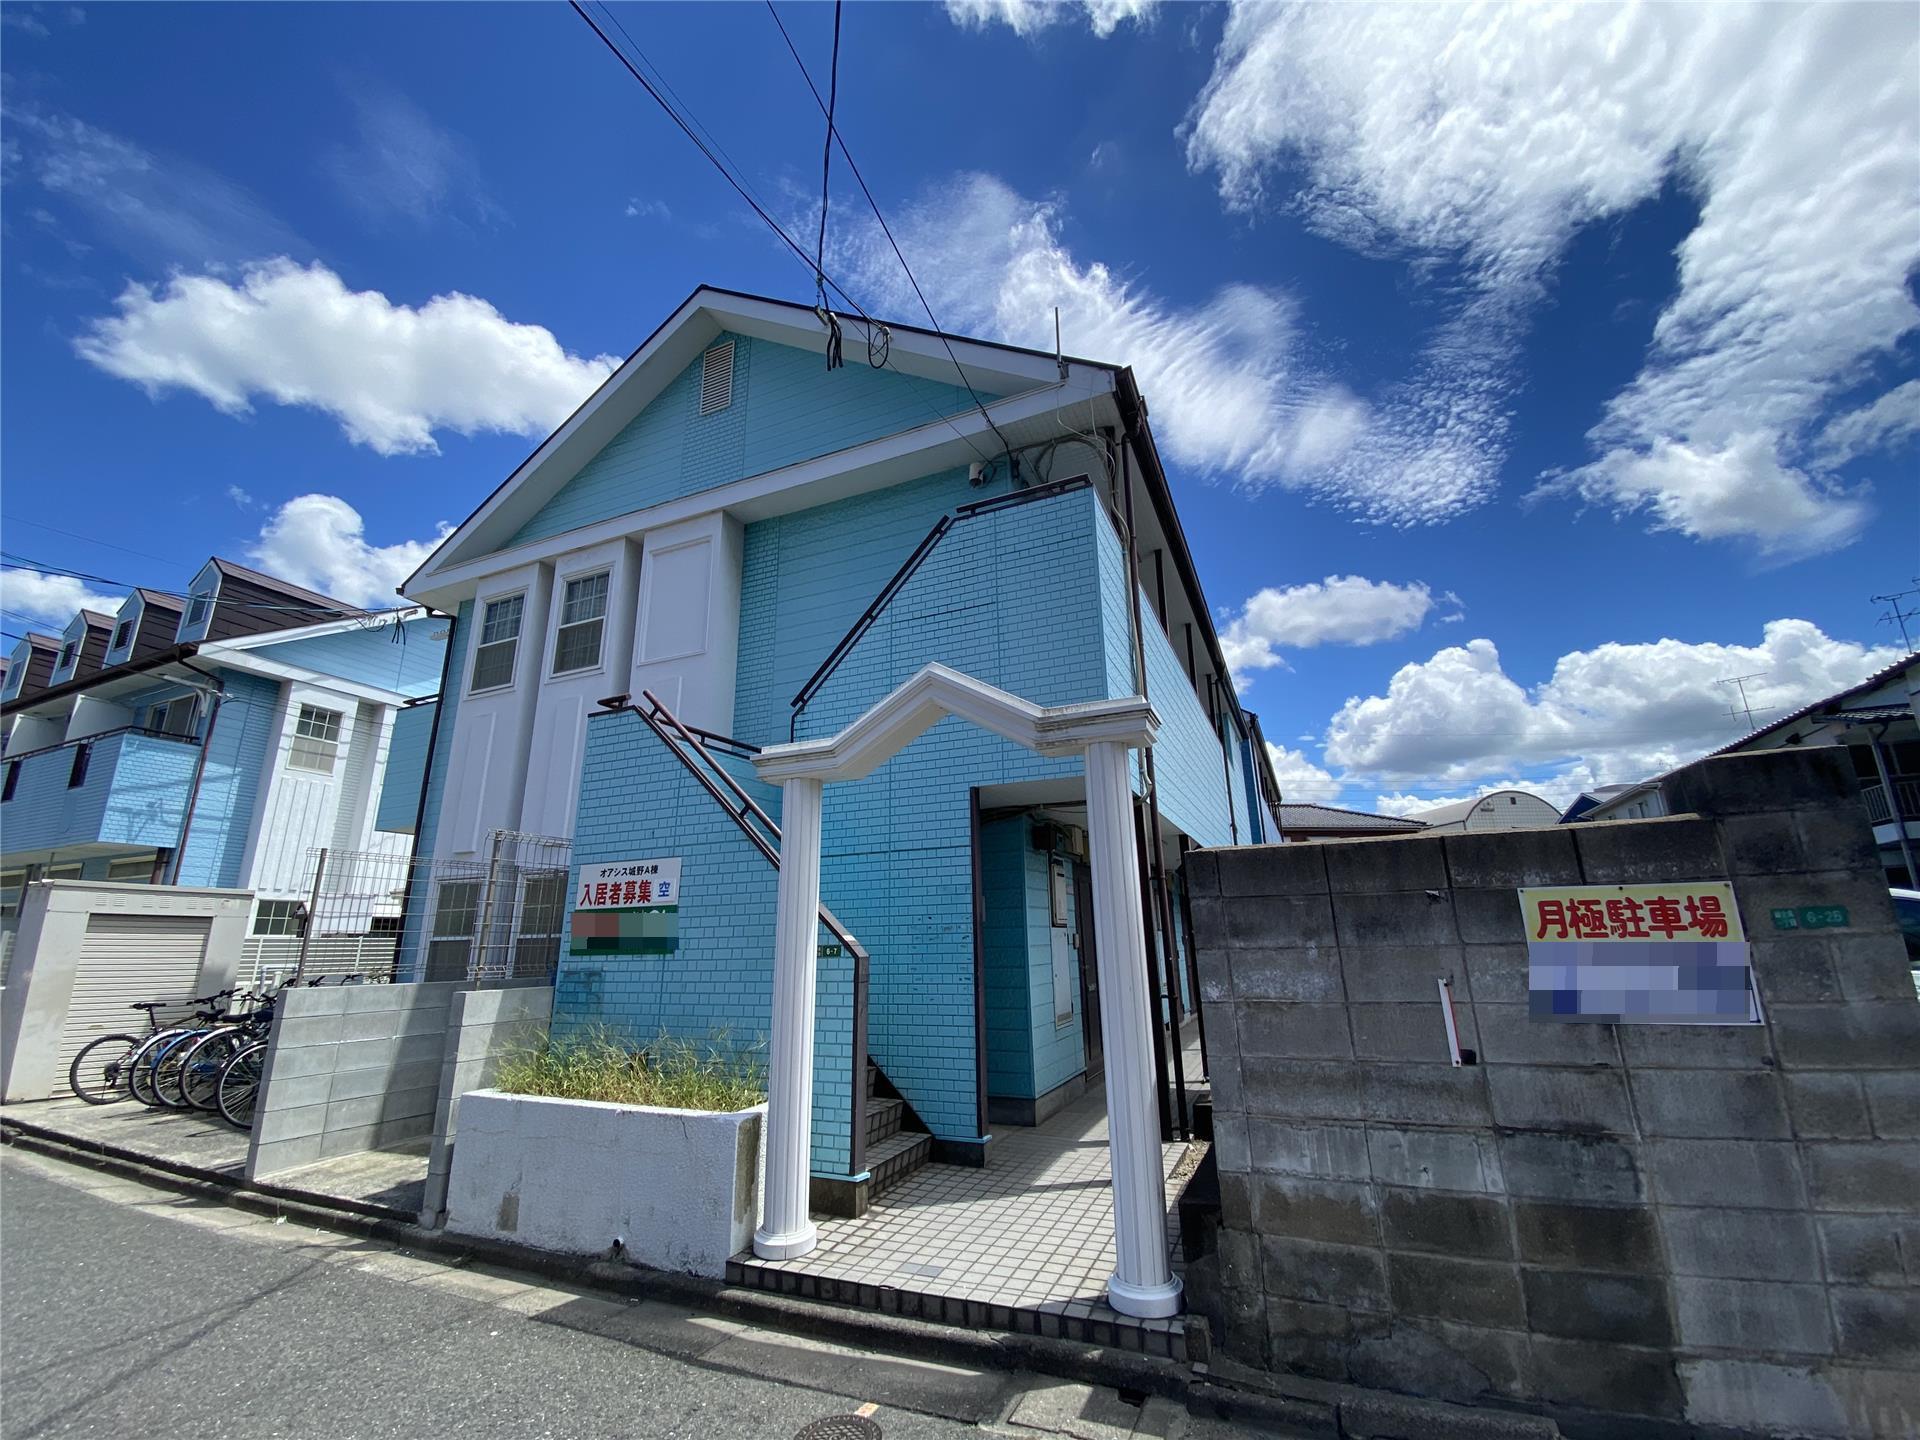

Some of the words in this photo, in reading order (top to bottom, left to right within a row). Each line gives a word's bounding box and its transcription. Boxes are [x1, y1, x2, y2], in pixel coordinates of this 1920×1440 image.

[600, 864, 659, 878] オアシス城野A棟
[579, 879, 652, 907] 入居者募集
[657, 880, 671, 898] 空
[1536, 894, 1730, 940] 月極駐車場
